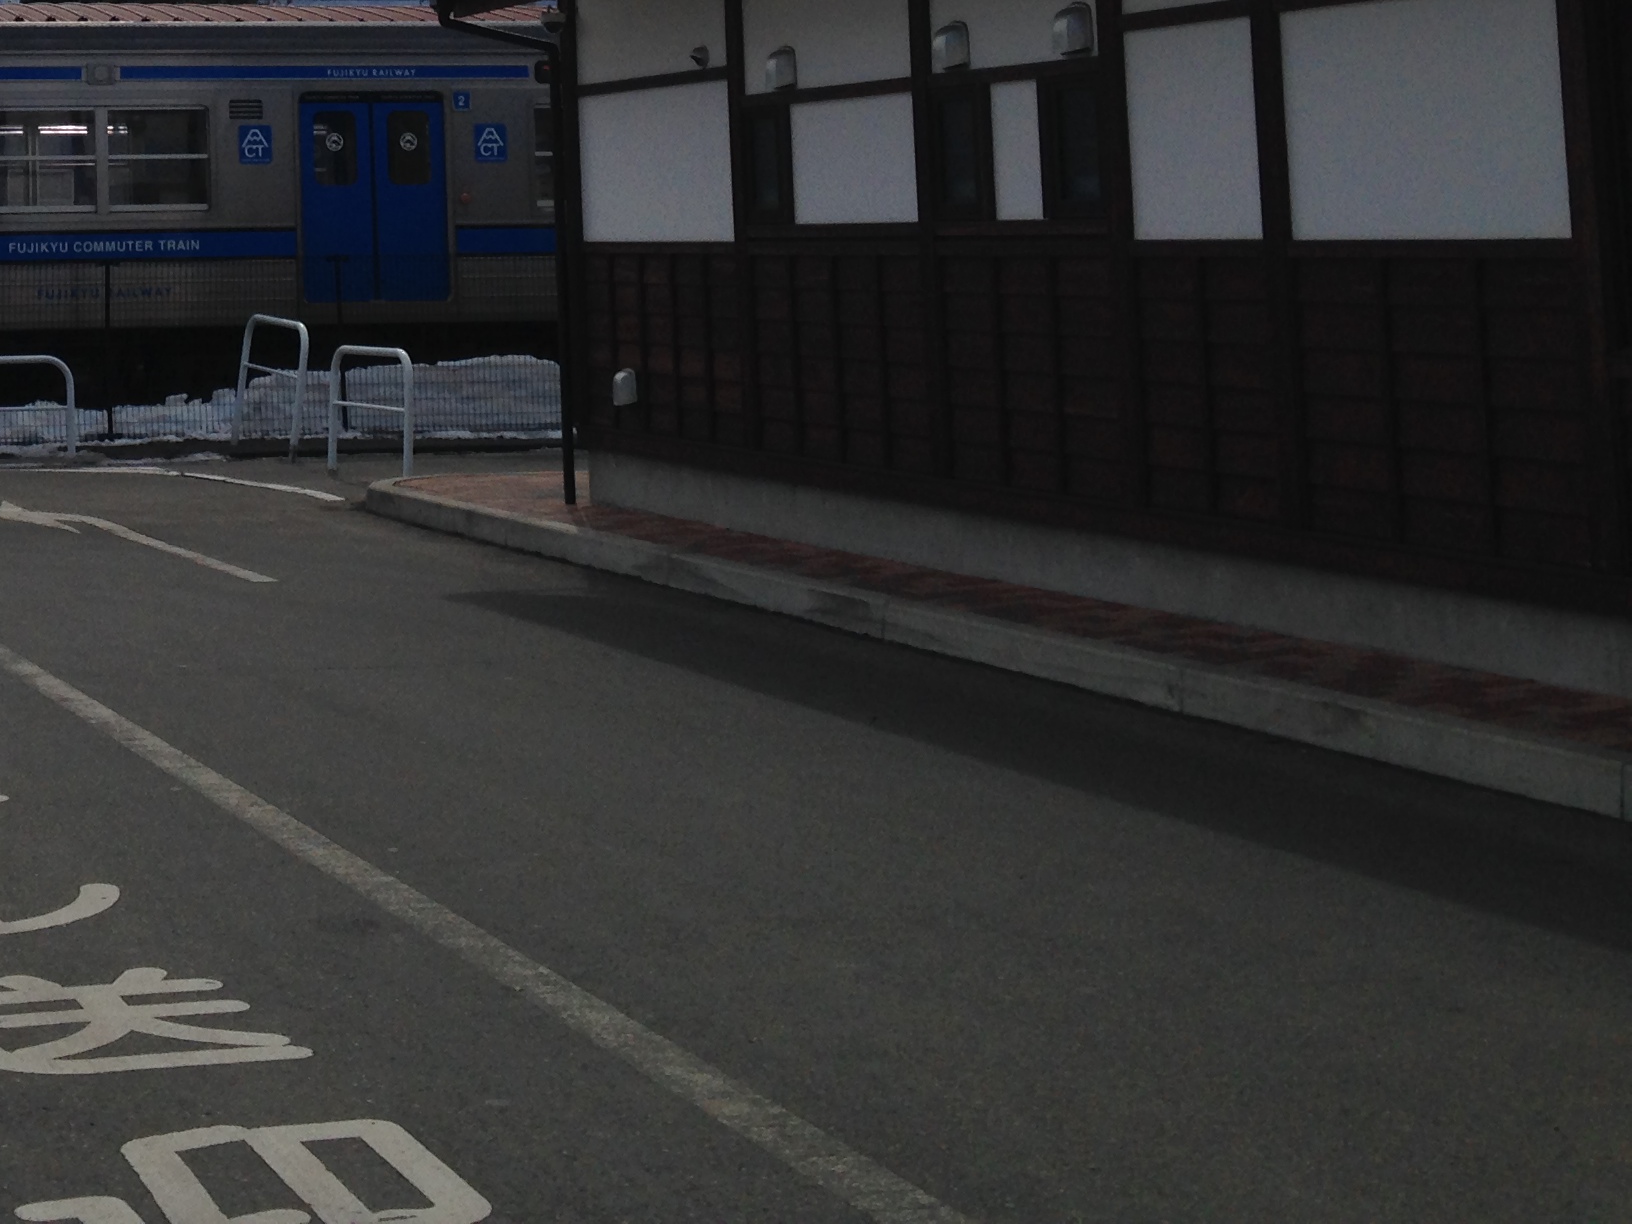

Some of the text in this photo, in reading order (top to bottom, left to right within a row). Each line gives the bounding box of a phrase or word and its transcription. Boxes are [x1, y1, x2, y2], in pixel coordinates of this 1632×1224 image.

[326, 68, 416, 77] FUJIKYU RAILWAY
[457, 95, 466, 107] 2
[9, 238, 200, 254] FUJIKYU COMMUTER TRAIN
[108, 286, 172, 299] AILWAY
